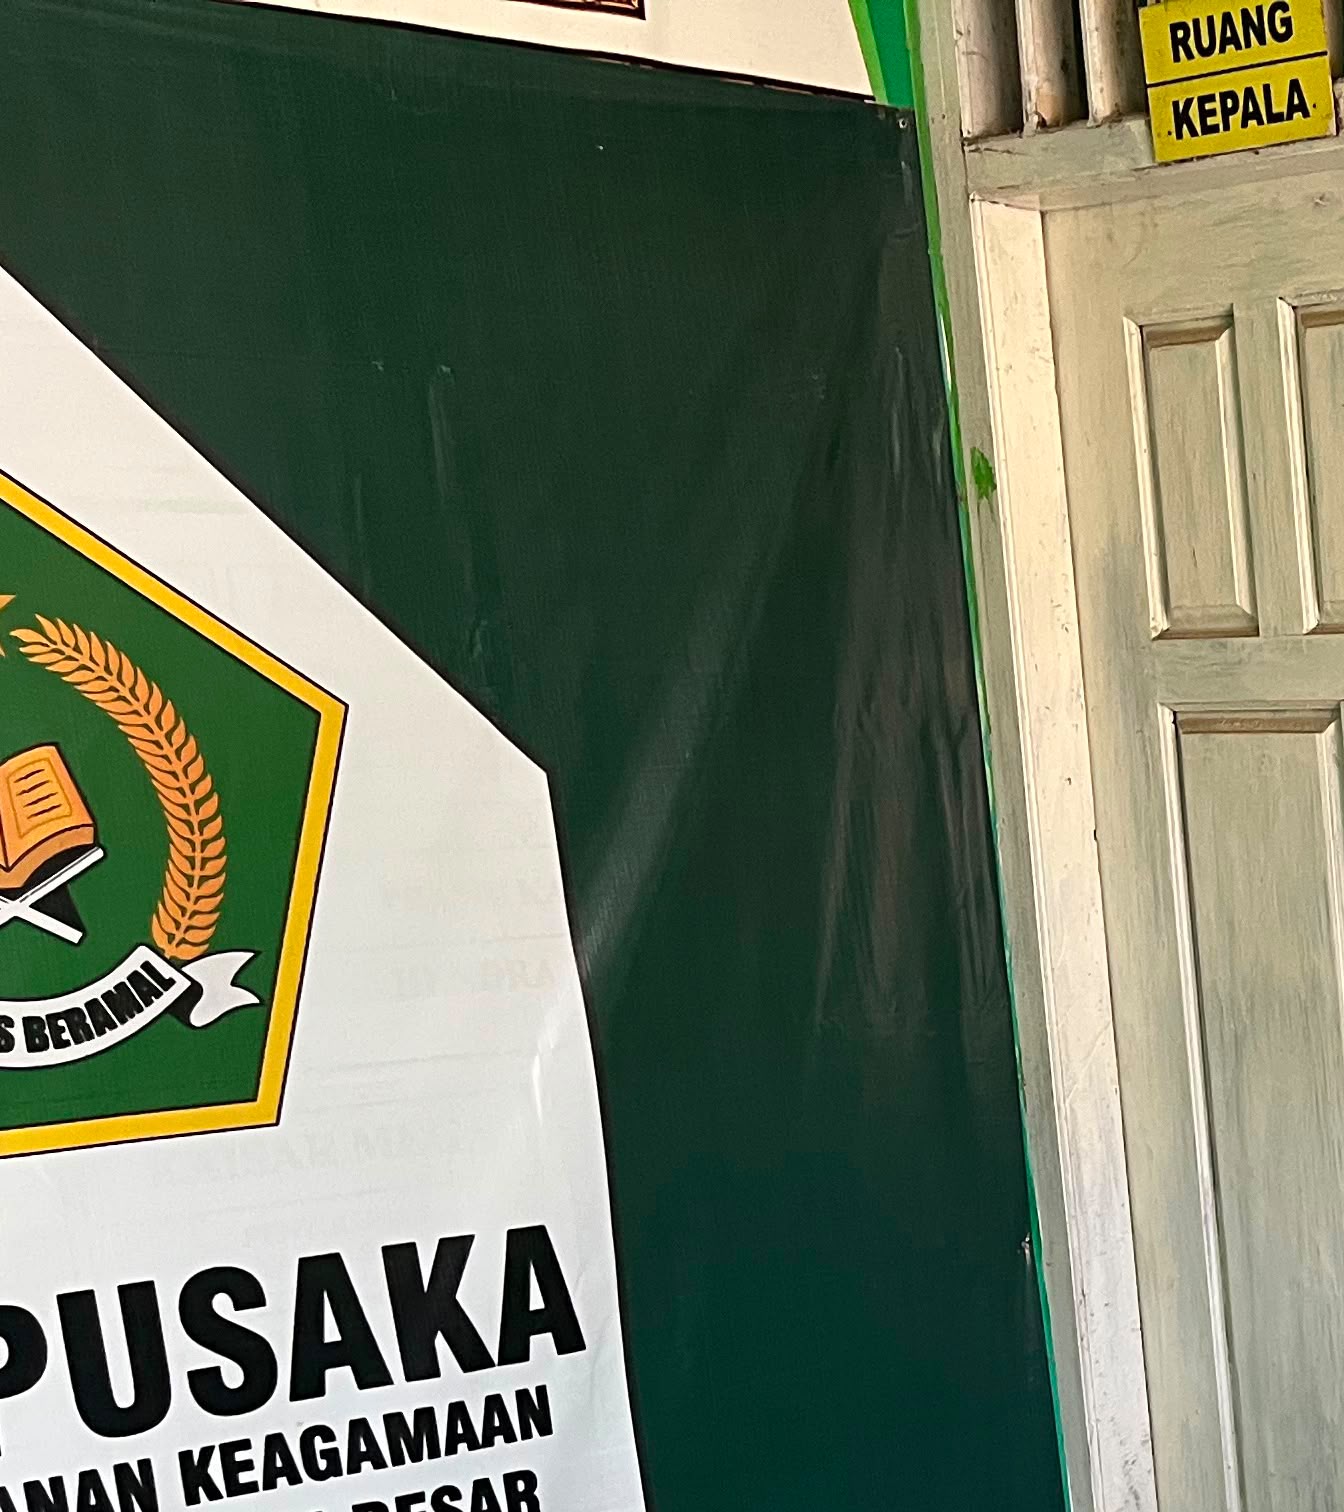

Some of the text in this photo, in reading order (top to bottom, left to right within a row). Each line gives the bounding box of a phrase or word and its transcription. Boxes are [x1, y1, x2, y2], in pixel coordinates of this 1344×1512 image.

[1169, 1, 1294, 63] RUANG
[1172, 78, 1311, 140] KEPALA
[22, 960, 177, 1053] BERAMAL
[178, 1384, 555, 1507] KEAGAMAAN
